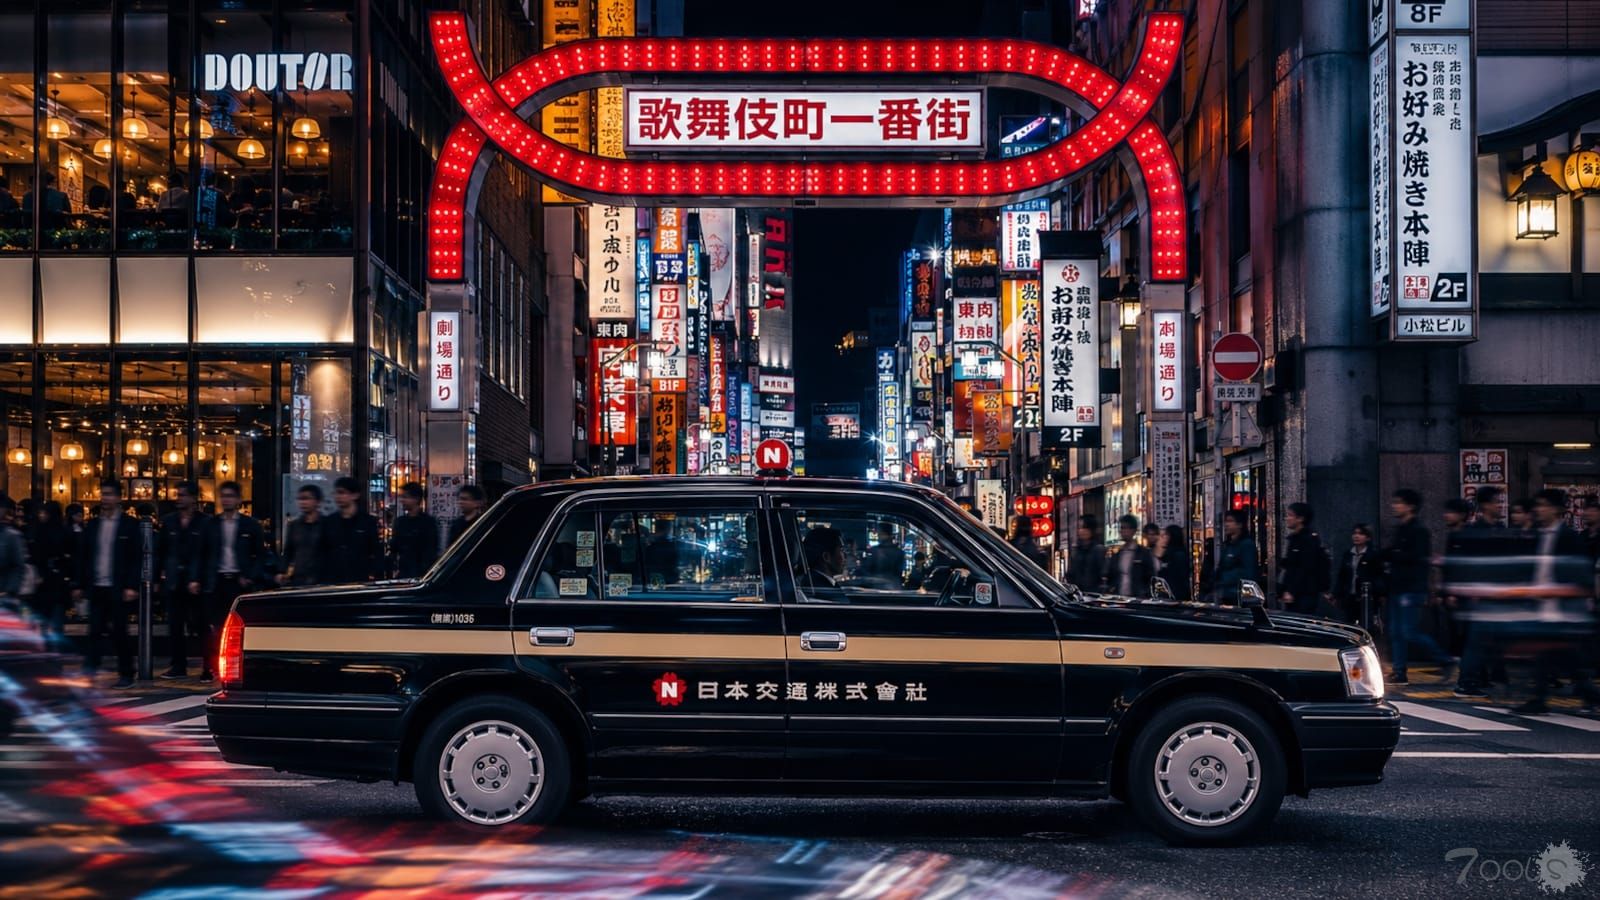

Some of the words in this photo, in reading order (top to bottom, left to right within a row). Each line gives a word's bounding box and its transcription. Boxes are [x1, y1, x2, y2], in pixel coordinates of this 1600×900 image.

[1410, 5, 1442, 24] 8F
[204, 54, 353, 91] DOUTOR
[638, 97, 970, 141] 歌舞伎町一番街
[1402, 60, 1430, 267] お好み焼き本陣
[1437, 278, 1465, 298] 2F
[1403, 317, 1465, 334] 小松ビル
[437, 319, 453, 402] 劇場通り
[659, 379, 680, 391] B1F
[1060, 427, 1084, 442] 2F
[764, 447, 781, 463] N
[661, 682, 678, 698] N
[698, 681, 928, 702] 日本交通株式會社
